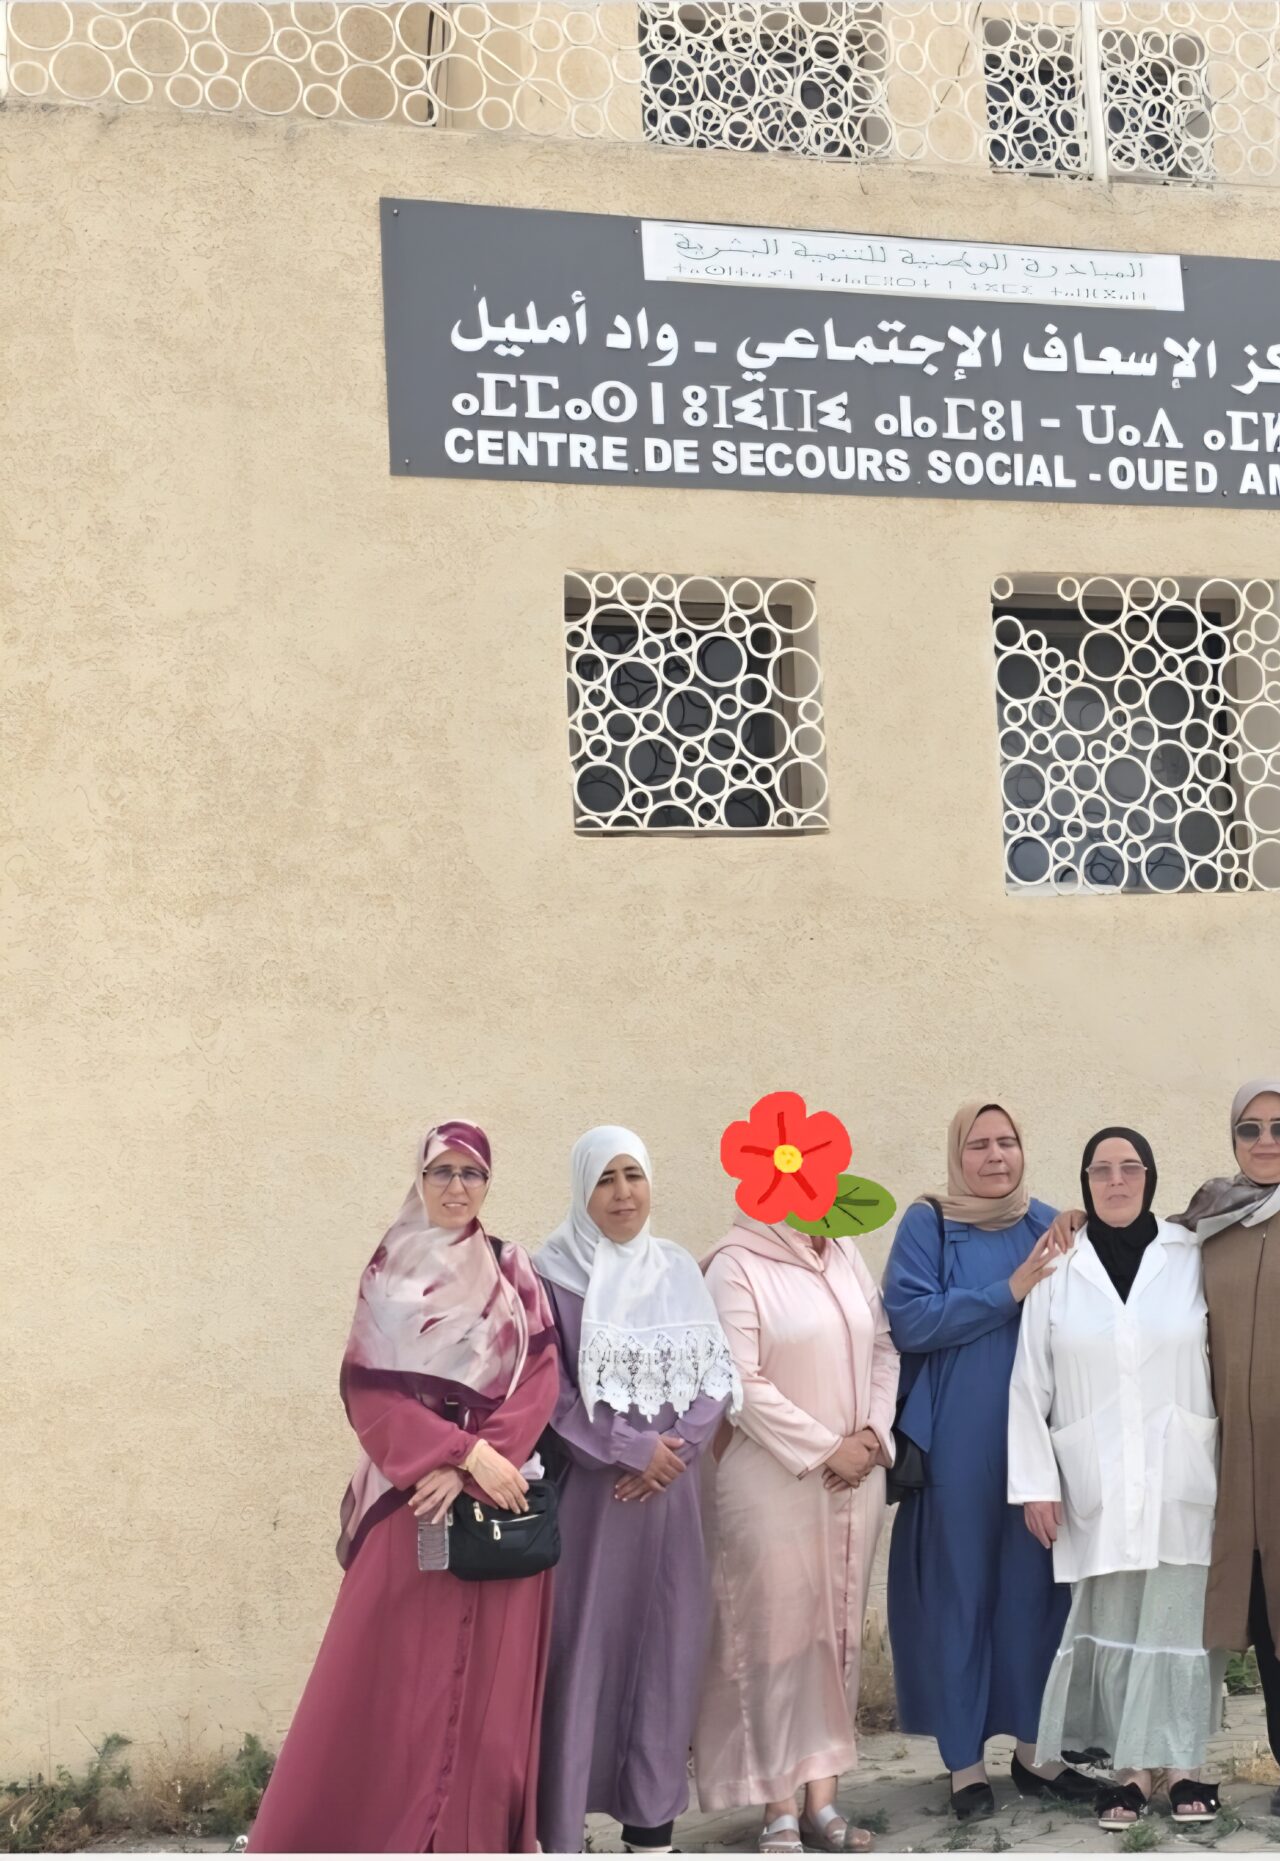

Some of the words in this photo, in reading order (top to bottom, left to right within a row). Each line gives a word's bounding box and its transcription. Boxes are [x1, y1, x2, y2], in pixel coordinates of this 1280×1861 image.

[451, 290, 588, 358] أمليل
[606, 306, 679, 367] واد
[737, 318, 1003, 382] الإجتماعي
[1023, 323, 1217, 389] الإسعاف
[444, 427, 629, 471] CENTRE
[645, 437, 700, 474] DE
[712, 440, 911, 482] SECOURS
[928, 449, 1077, 488] SOCIAL
